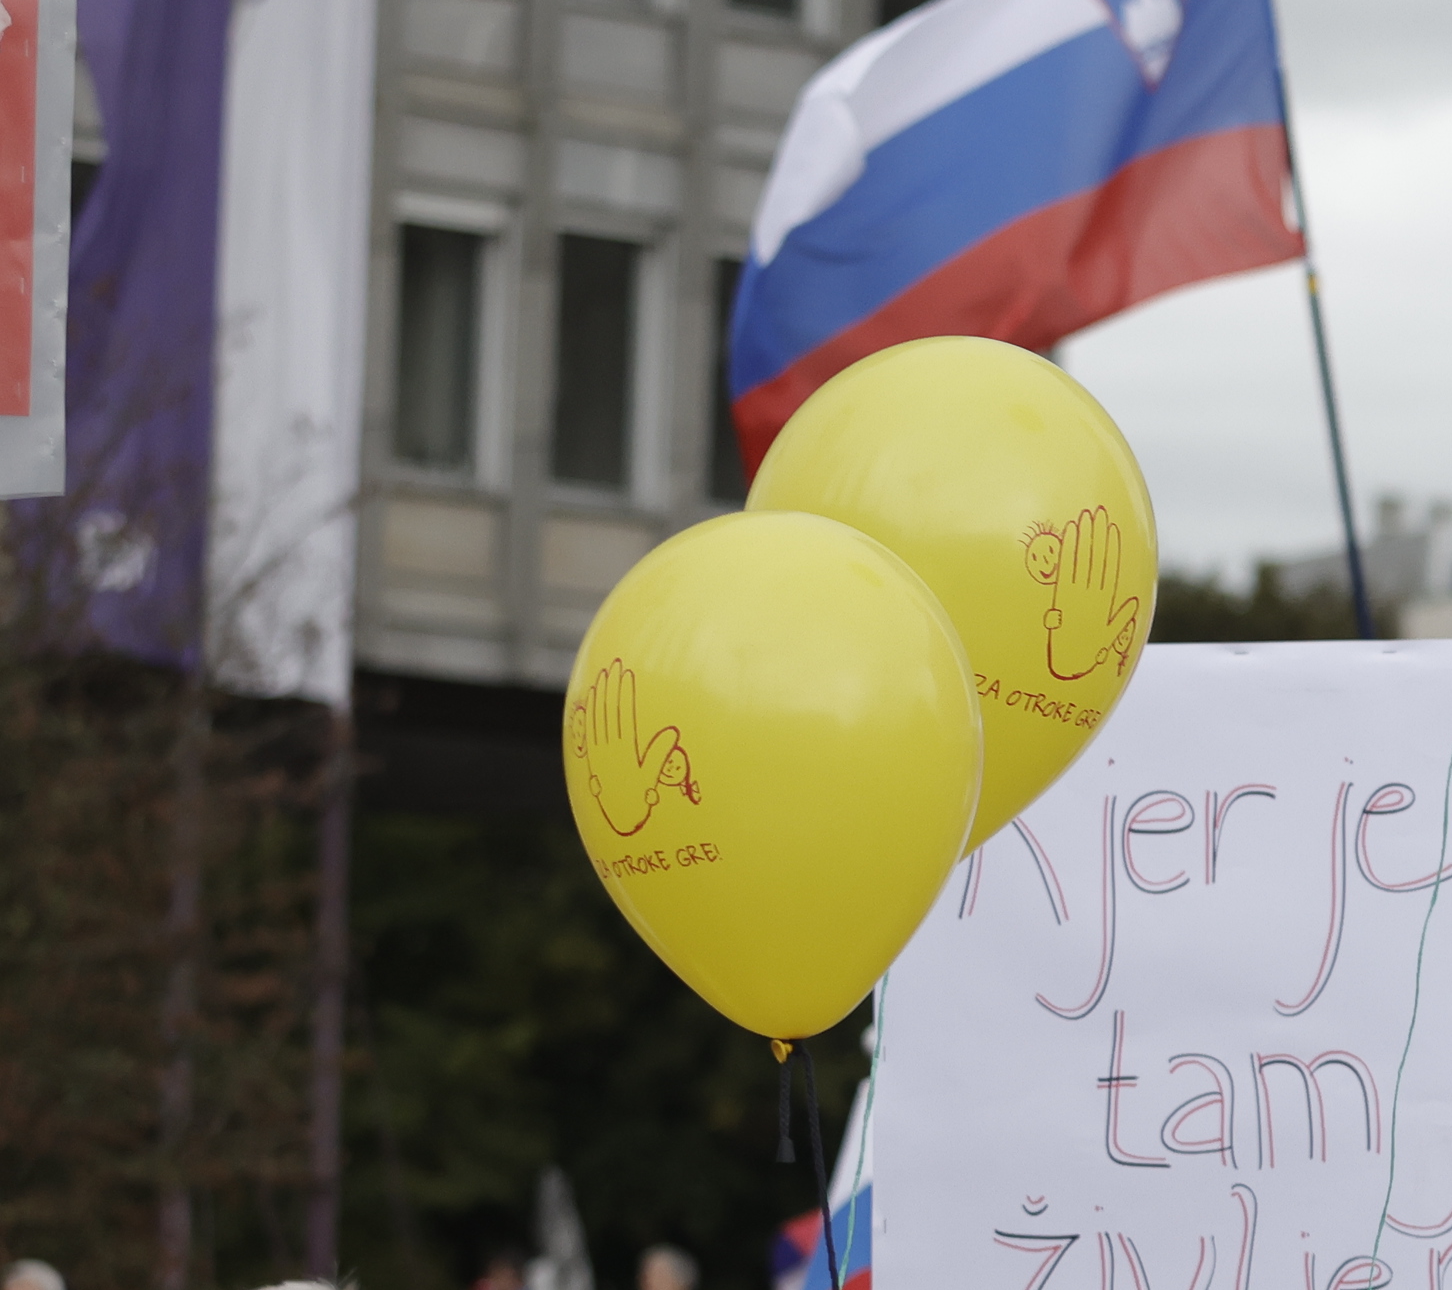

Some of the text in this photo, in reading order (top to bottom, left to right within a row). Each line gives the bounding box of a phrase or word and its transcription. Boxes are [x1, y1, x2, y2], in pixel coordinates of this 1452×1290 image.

[1006, 690, 1076, 722] OTROKE
[612, 850, 671, 877] OTROKE
[676, 843, 724, 867] GRE!
[1096, 1009, 1381, 1169] tam
